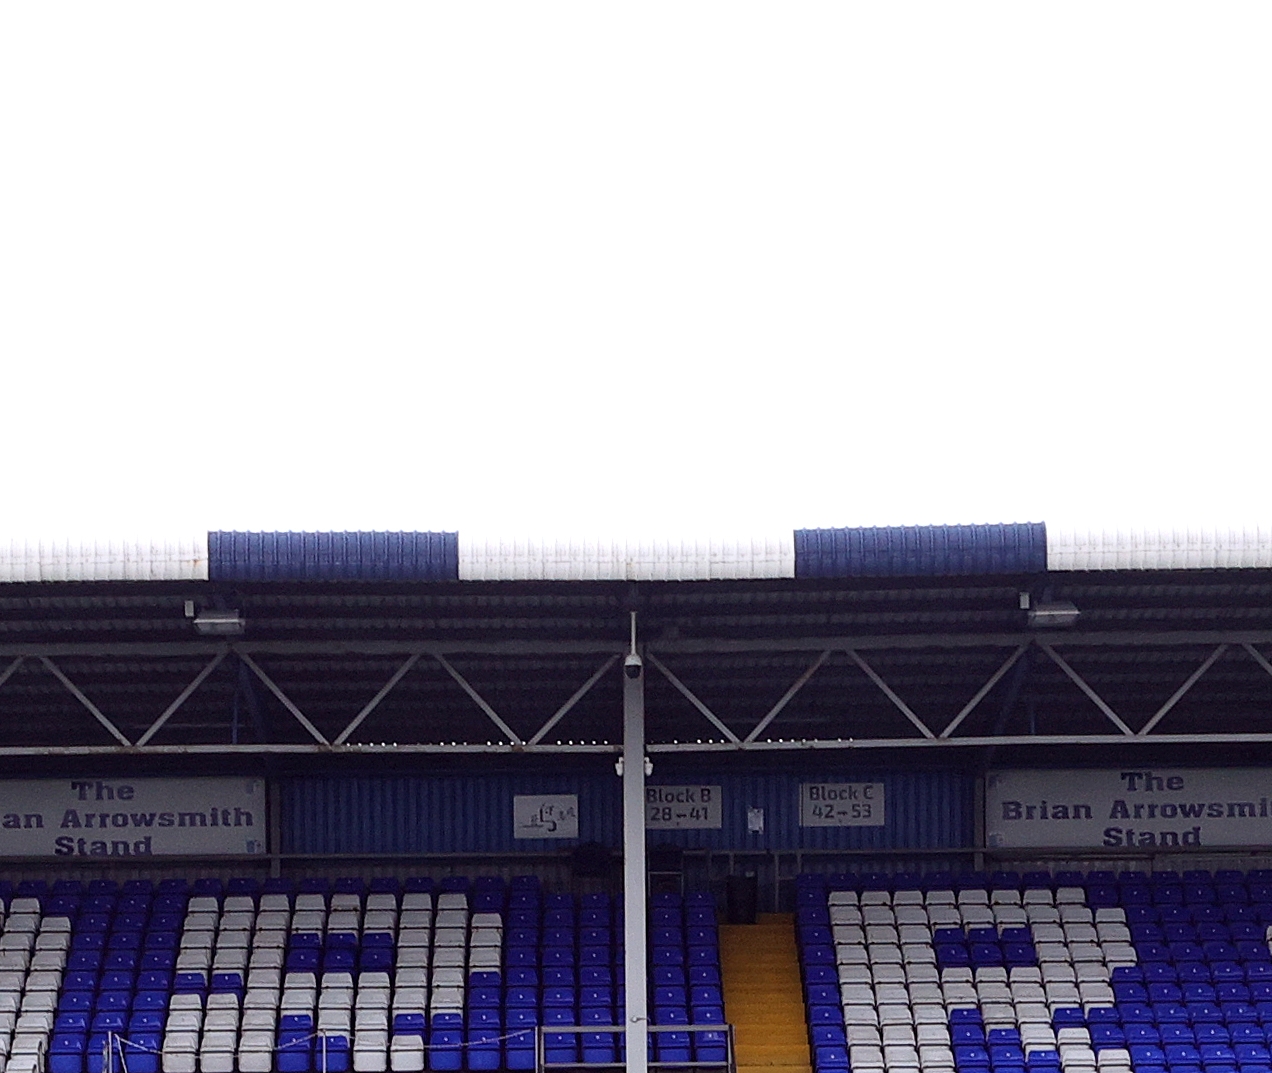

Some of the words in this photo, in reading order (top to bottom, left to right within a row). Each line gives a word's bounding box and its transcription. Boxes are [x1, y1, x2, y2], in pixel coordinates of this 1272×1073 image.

[71, 780, 134, 801] The
[1121, 771, 1184, 792] The
[646, 788, 695, 804] Block
[701, 788, 711, 802] B
[809, 785, 858, 801] Block
[863, 785, 874, 799] C
[60, 807, 254, 829] Arrowsmith
[1001, 800, 1093, 821] Brian
[54, 836, 153, 857] Stand
[1103, 826, 1202, 848] Stand
